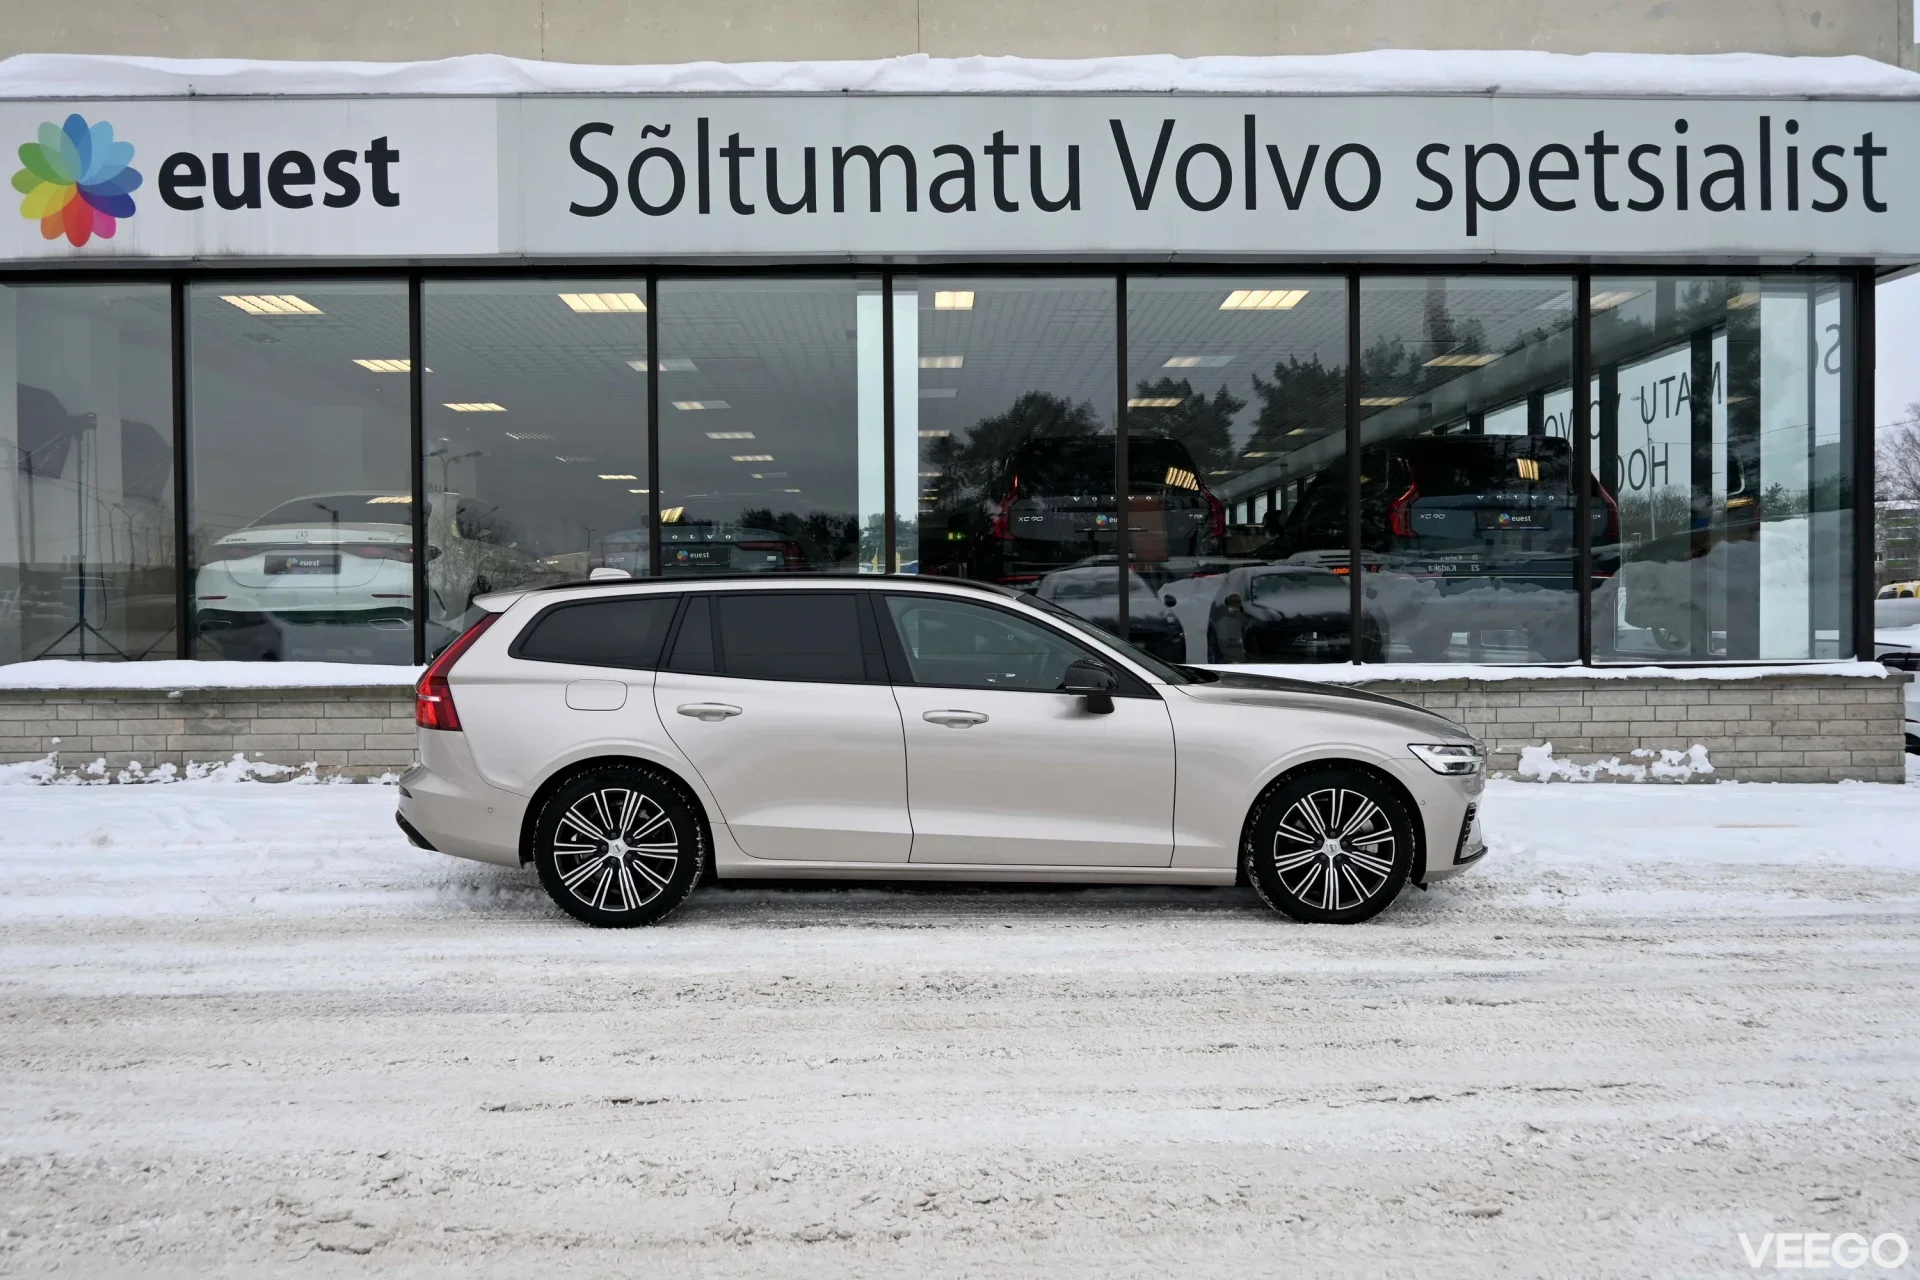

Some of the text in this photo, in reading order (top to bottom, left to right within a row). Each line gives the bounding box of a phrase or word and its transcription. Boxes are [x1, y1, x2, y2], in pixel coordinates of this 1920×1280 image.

[158, 136, 400, 211] euest
[568, 114, 1888, 237] Sõltumatu Volvo spetsialist
[1511, 514, 1532, 523] euest
[689, 551, 710, 559] euest
[299, 558, 320, 567] euest
